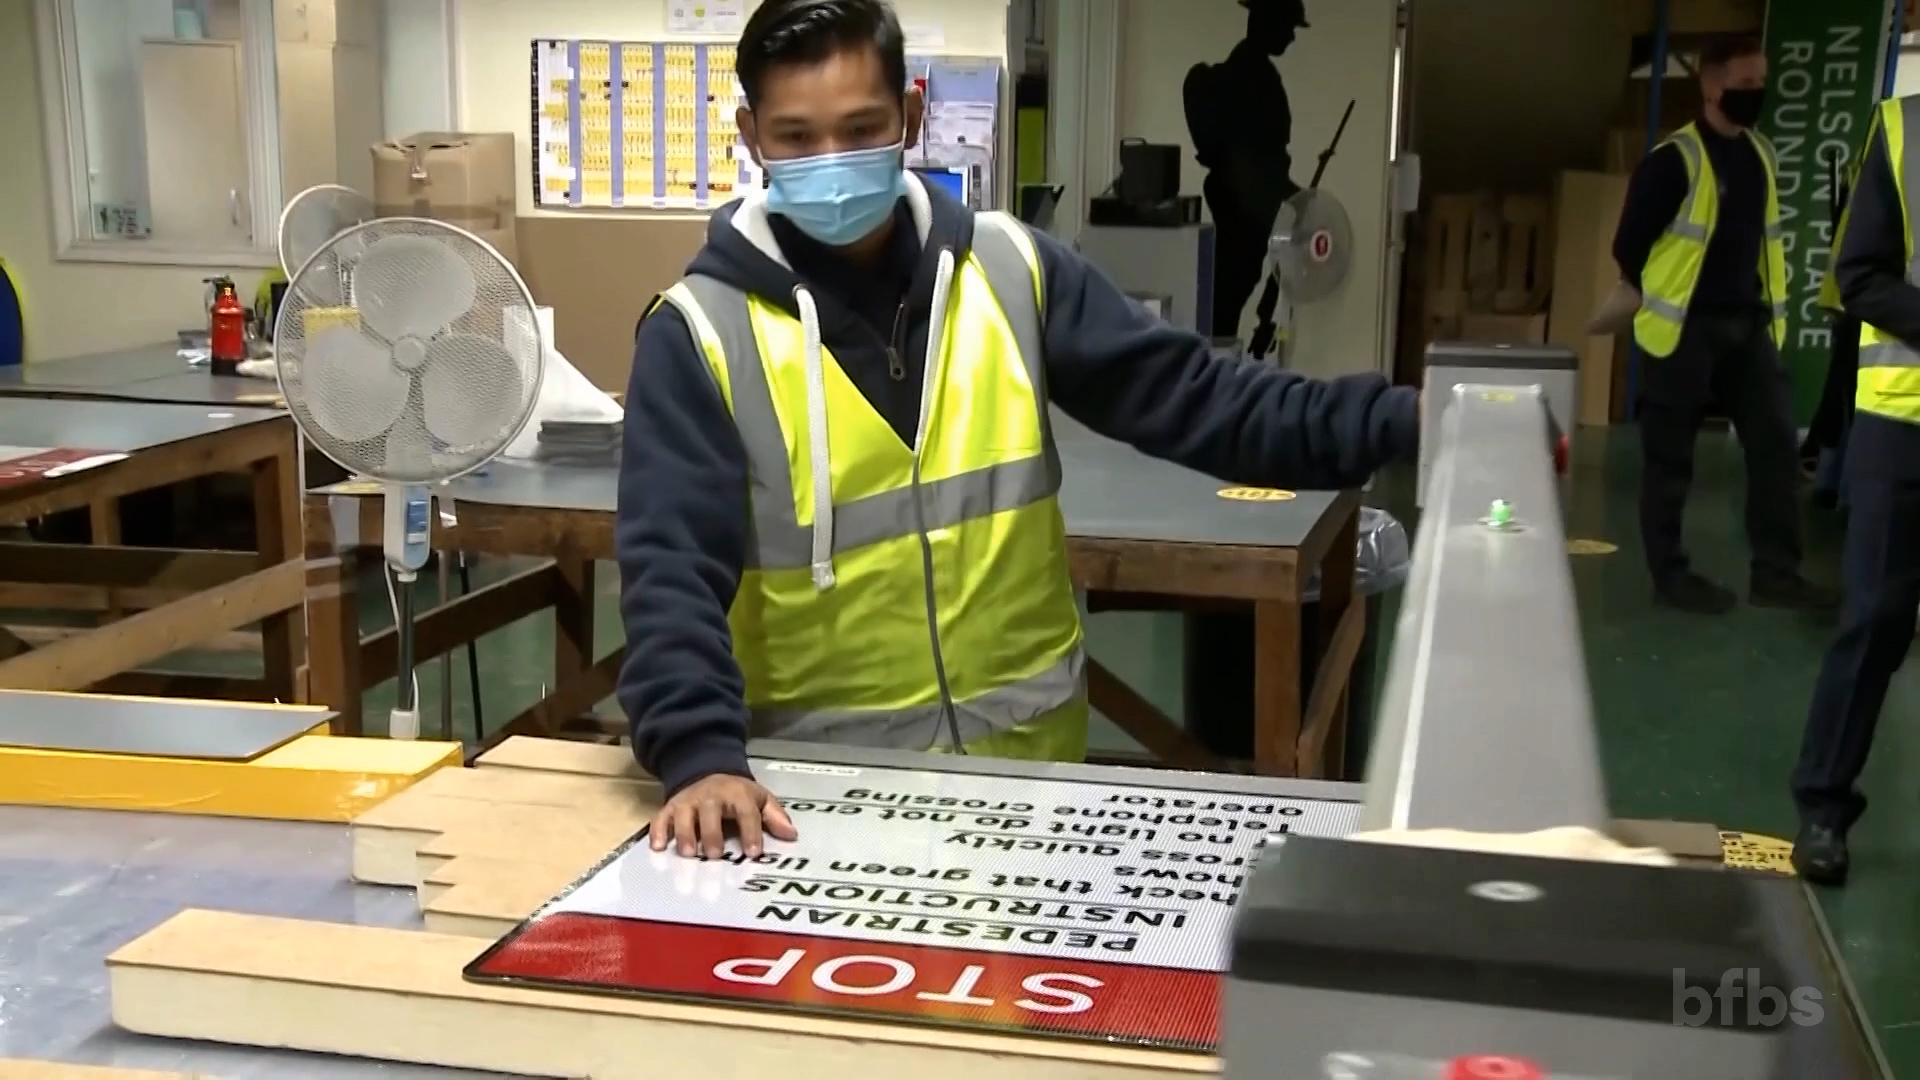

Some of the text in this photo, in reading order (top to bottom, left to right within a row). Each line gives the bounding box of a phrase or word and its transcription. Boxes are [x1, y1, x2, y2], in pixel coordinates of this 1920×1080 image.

[1772, 41, 1815, 290] ROUNDA
[1799, 25, 1863, 348] NELSON PLACE
[780, 801, 1234, 844] no light do not cro
[842, 788, 1297, 834] Telephone crossing
[1102, 794, 1304, 817] operator
[945, 832, 1258, 868] ross quickly
[695, 852, 1239, 906] heck that green ligh
[1113, 865, 1244, 888] hows
[738, 879, 1187, 928] INSTRUCTIONS
[756, 904, 1139, 951] PEDESTRIAN
[712, 948, 1105, 1014] STOP
